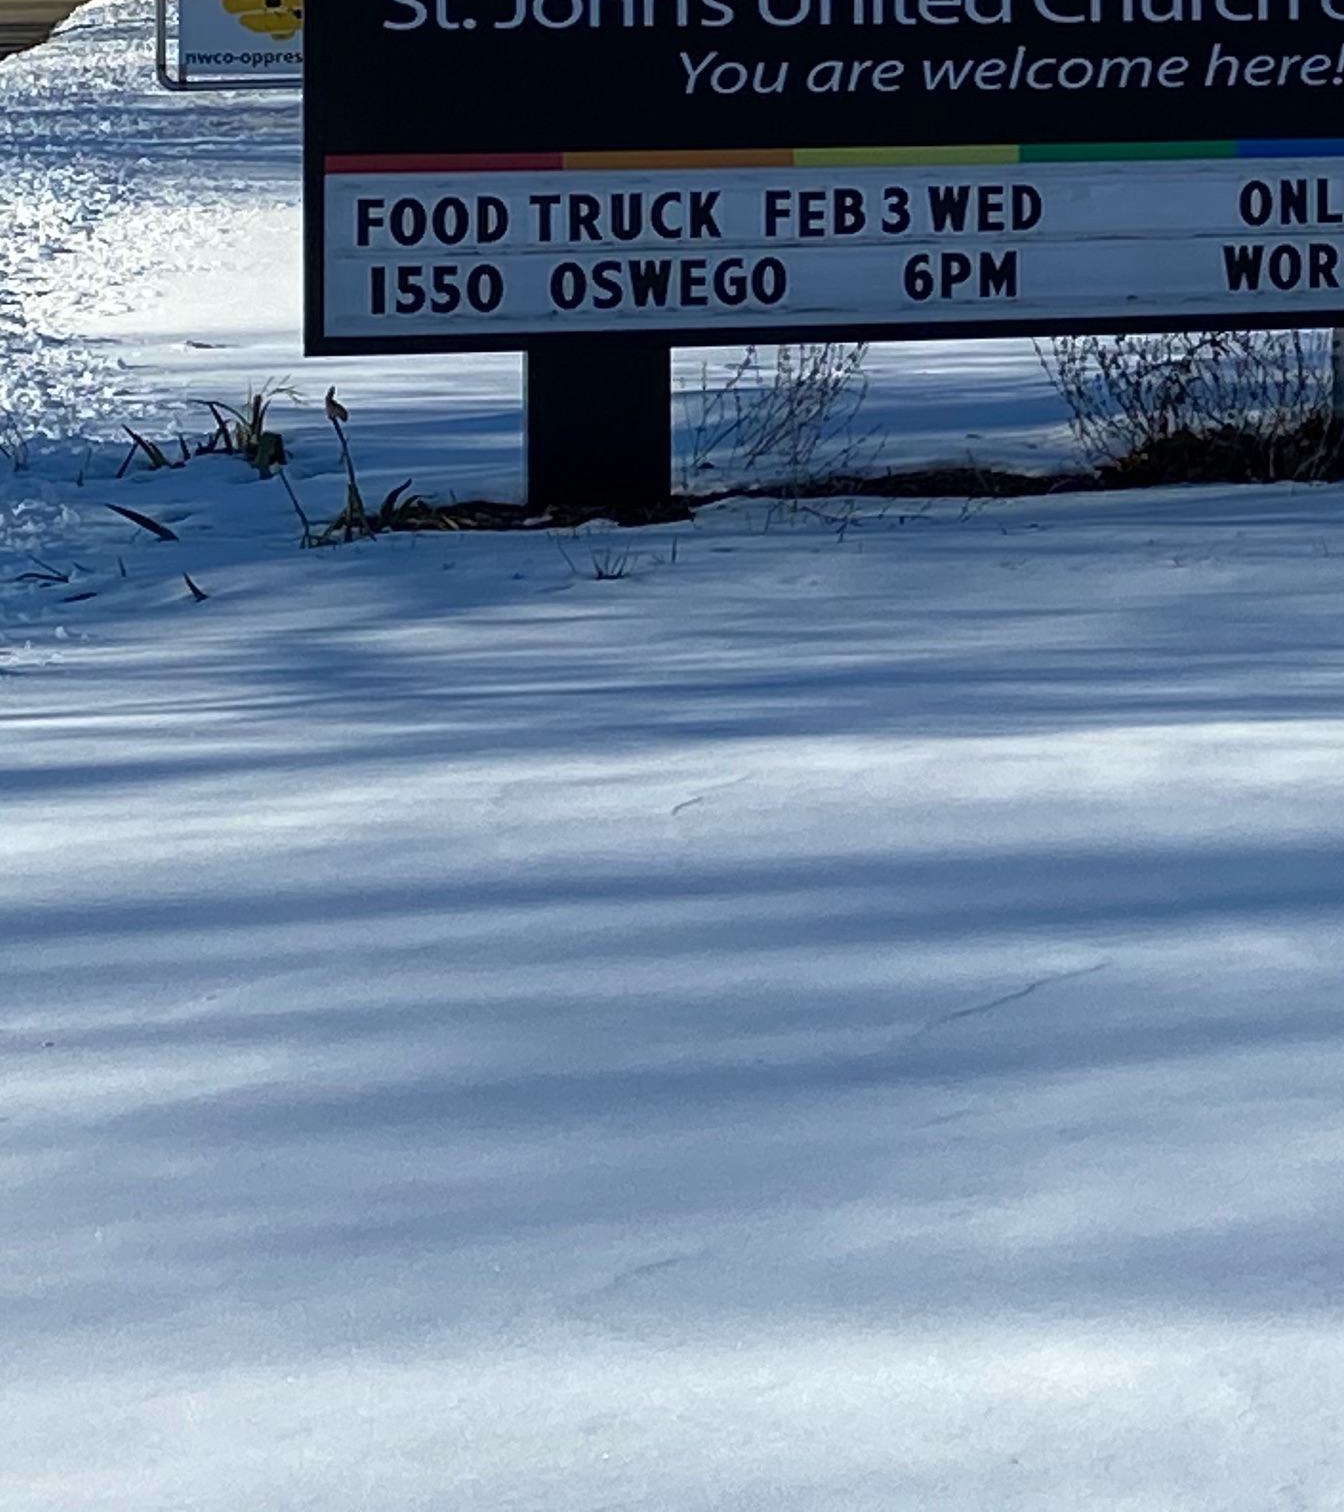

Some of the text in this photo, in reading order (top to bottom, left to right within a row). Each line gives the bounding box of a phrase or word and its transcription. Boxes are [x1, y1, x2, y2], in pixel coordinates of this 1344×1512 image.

[680, 51, 788, 94] You
[807, 61, 904, 92] are
[923, 46, 1188, 90] welcome
[357, 185, 1041, 246] FOOD TRUCK FEB 3 WED
[371, 251, 1018, 315] 1550 OSWEGO 6PM
